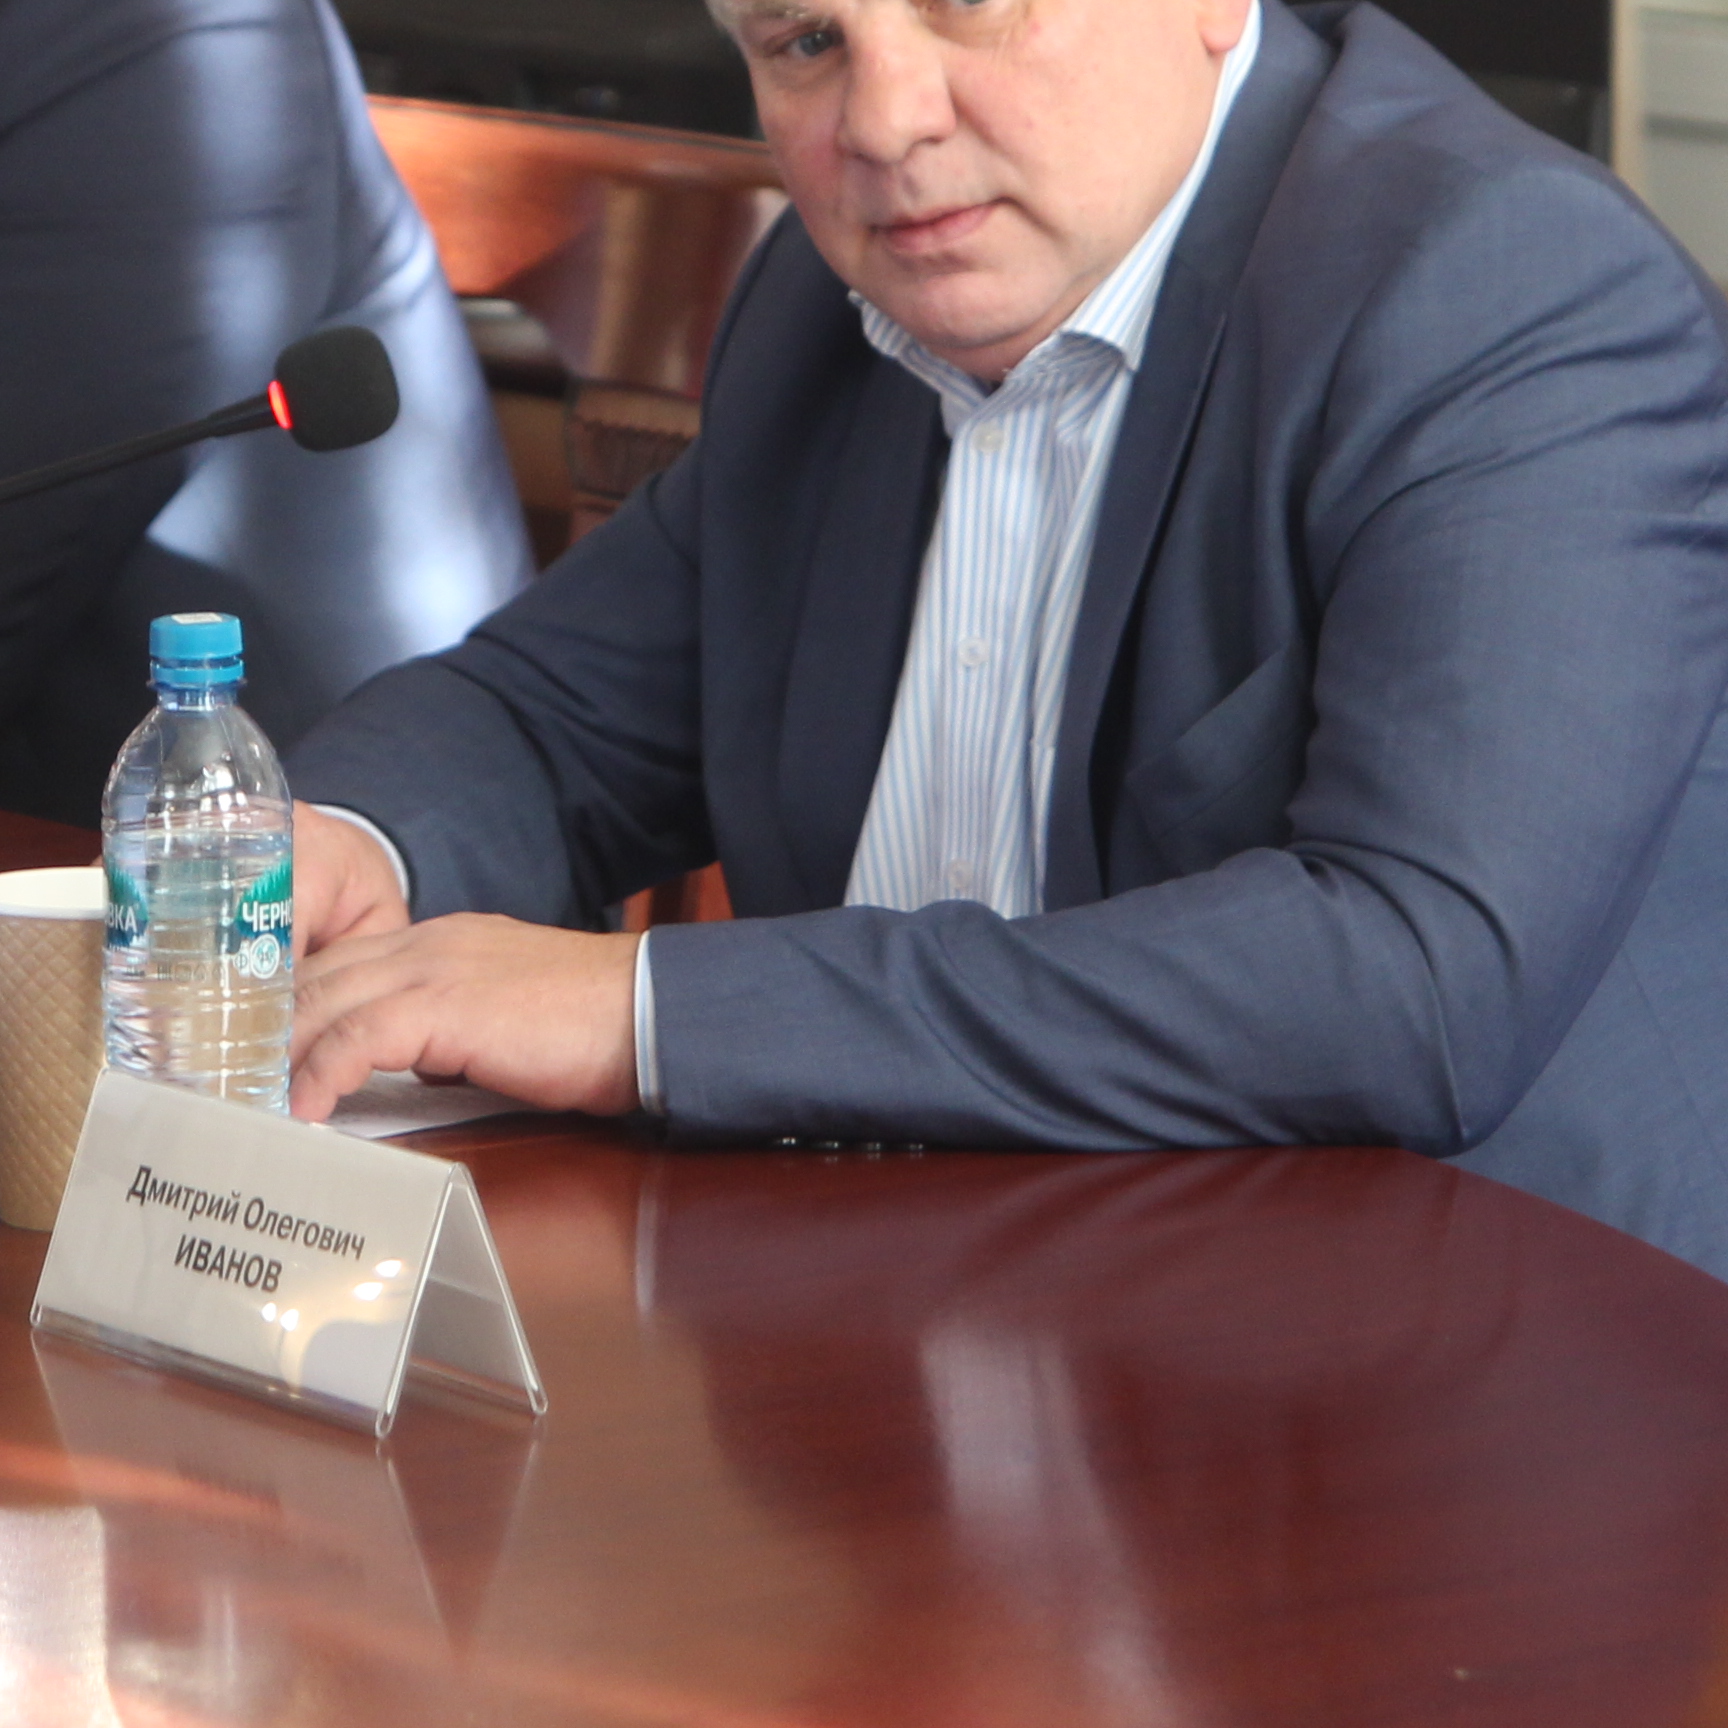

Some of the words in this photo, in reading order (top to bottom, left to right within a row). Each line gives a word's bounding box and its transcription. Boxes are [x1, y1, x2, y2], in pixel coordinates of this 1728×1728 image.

[126, 1164, 241, 1225] Дмитрий
[243, 1196, 366, 1261] Олегович
[174, 1234, 283, 1293] ИВАНОВ
